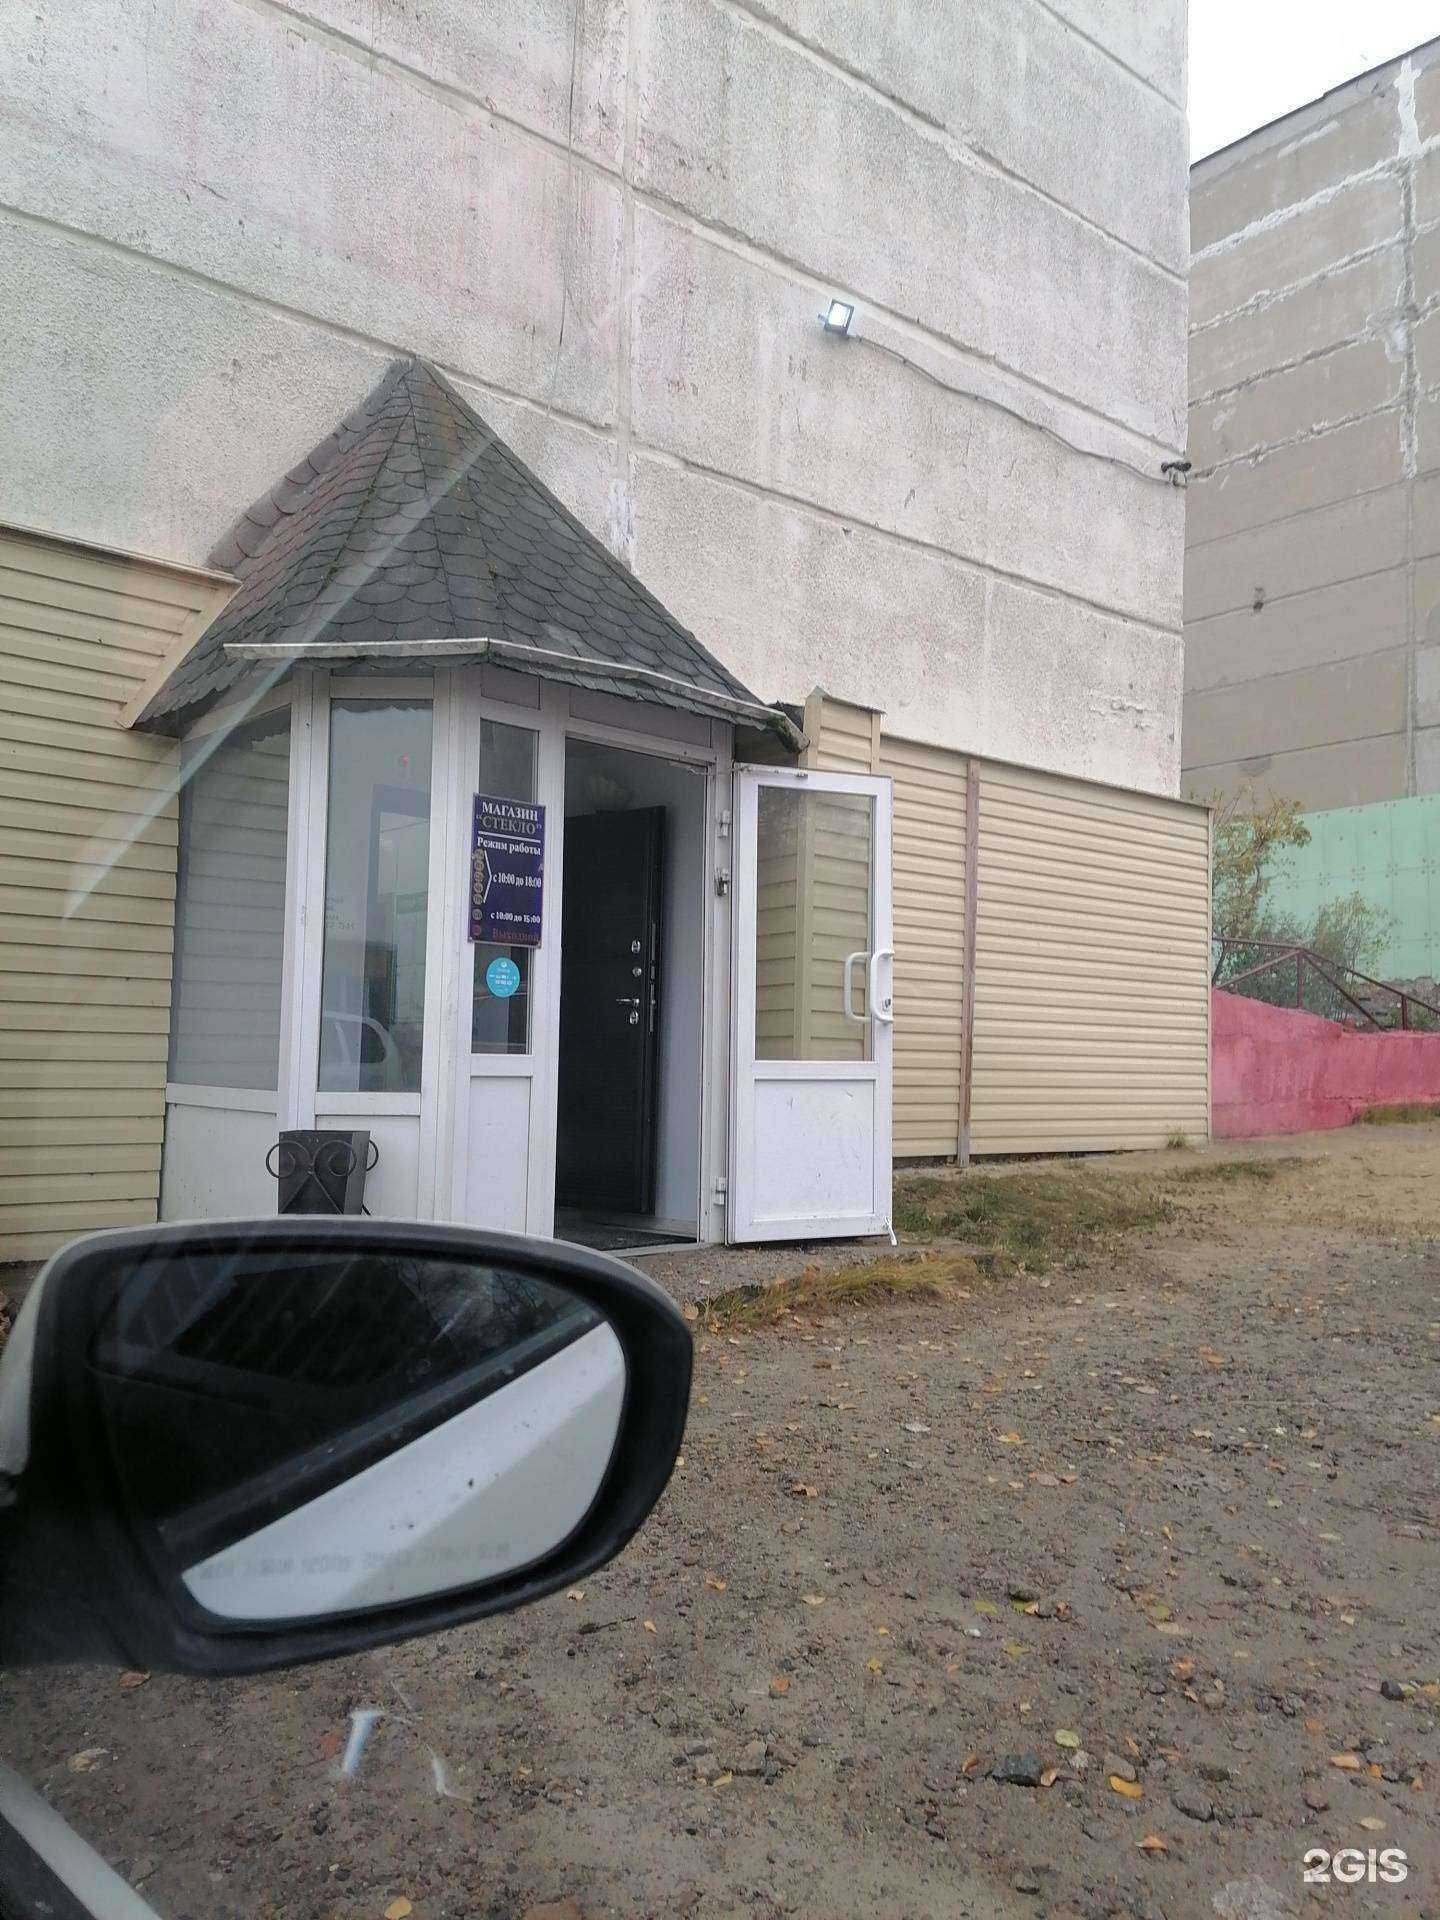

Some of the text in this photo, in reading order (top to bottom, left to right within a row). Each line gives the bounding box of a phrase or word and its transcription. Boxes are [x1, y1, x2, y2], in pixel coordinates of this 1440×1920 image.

[482, 801, 538, 821] МАГАЗИН
[477, 836, 541, 856] Режим работы
[498, 872, 515, 885] 10:00
[515, 877, 525, 887] до
[496, 911, 514, 921] 10:00
[513, 914, 523, 922] до
